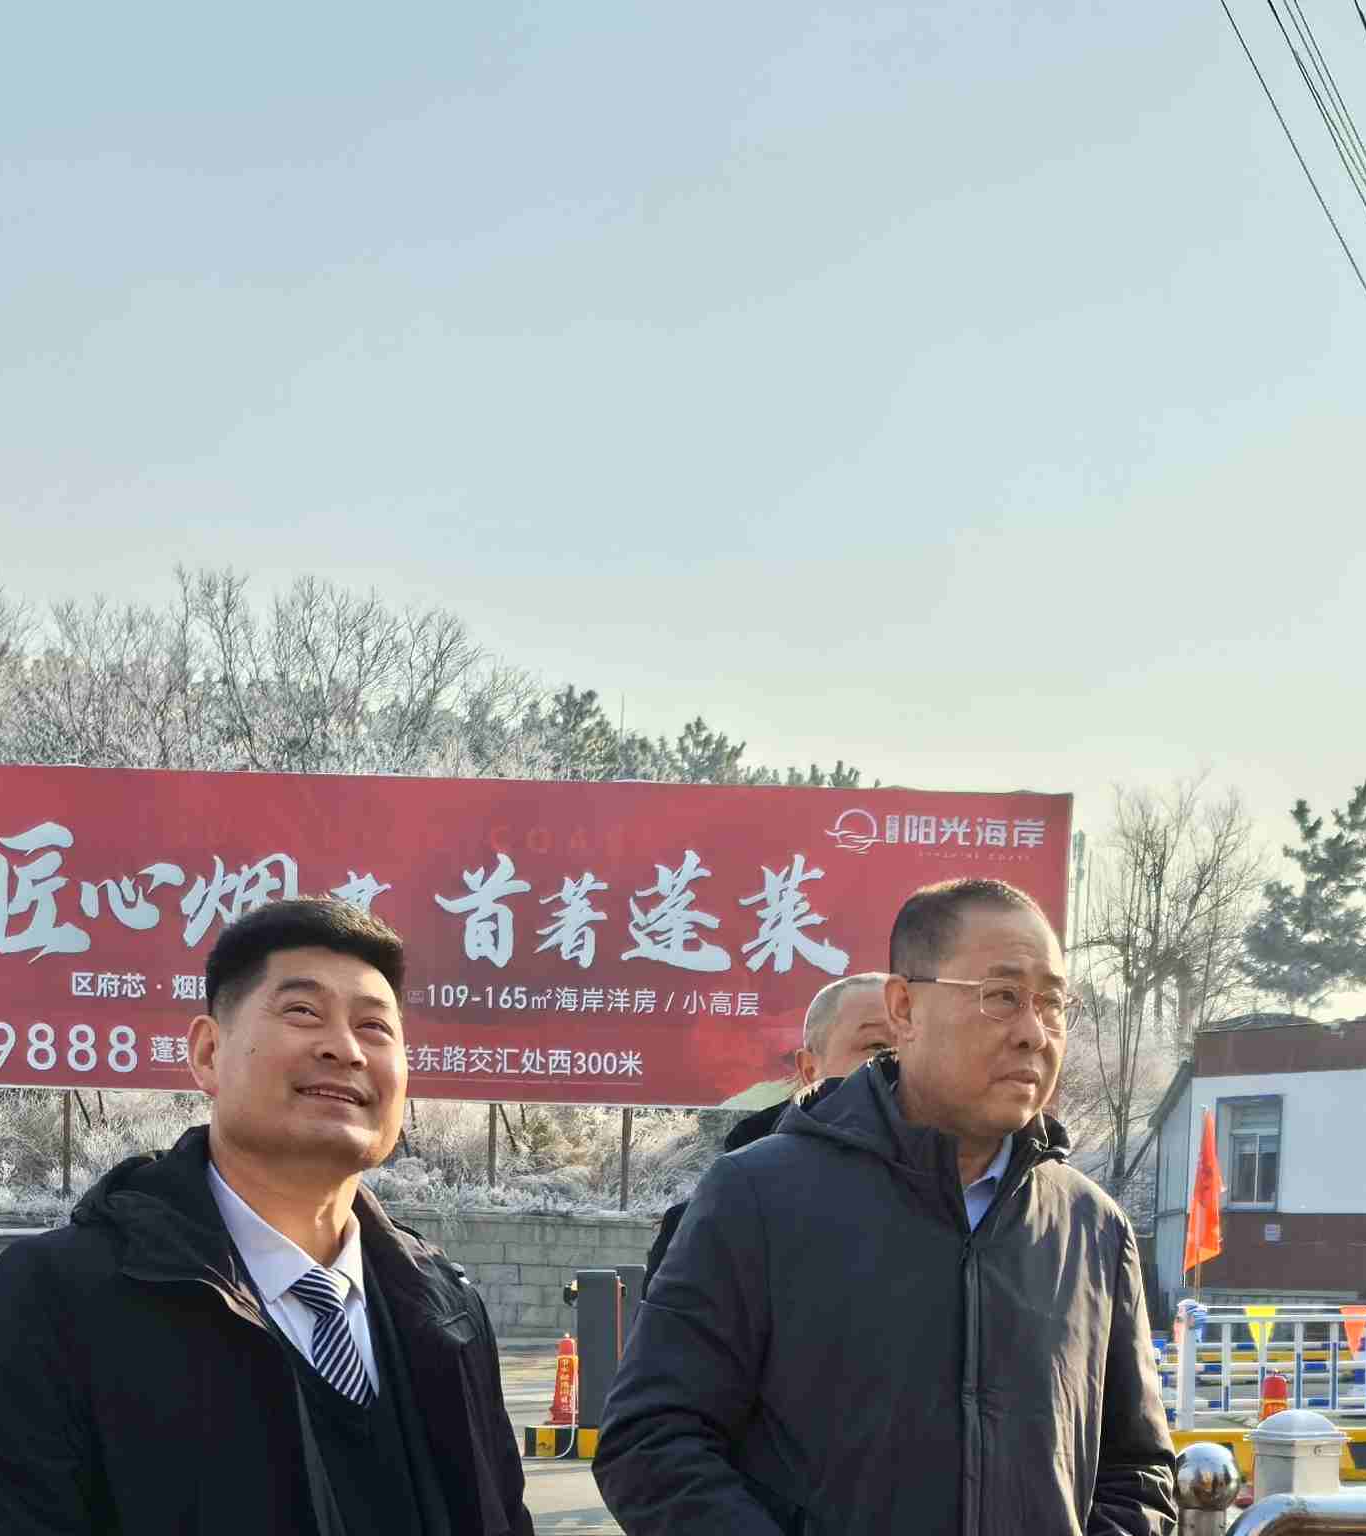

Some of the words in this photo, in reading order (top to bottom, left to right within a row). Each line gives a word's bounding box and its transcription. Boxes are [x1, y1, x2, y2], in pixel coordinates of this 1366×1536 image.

[904, 815, 1046, 849] 阳光海岸
[683, 991, 760, 1016] 小高层
